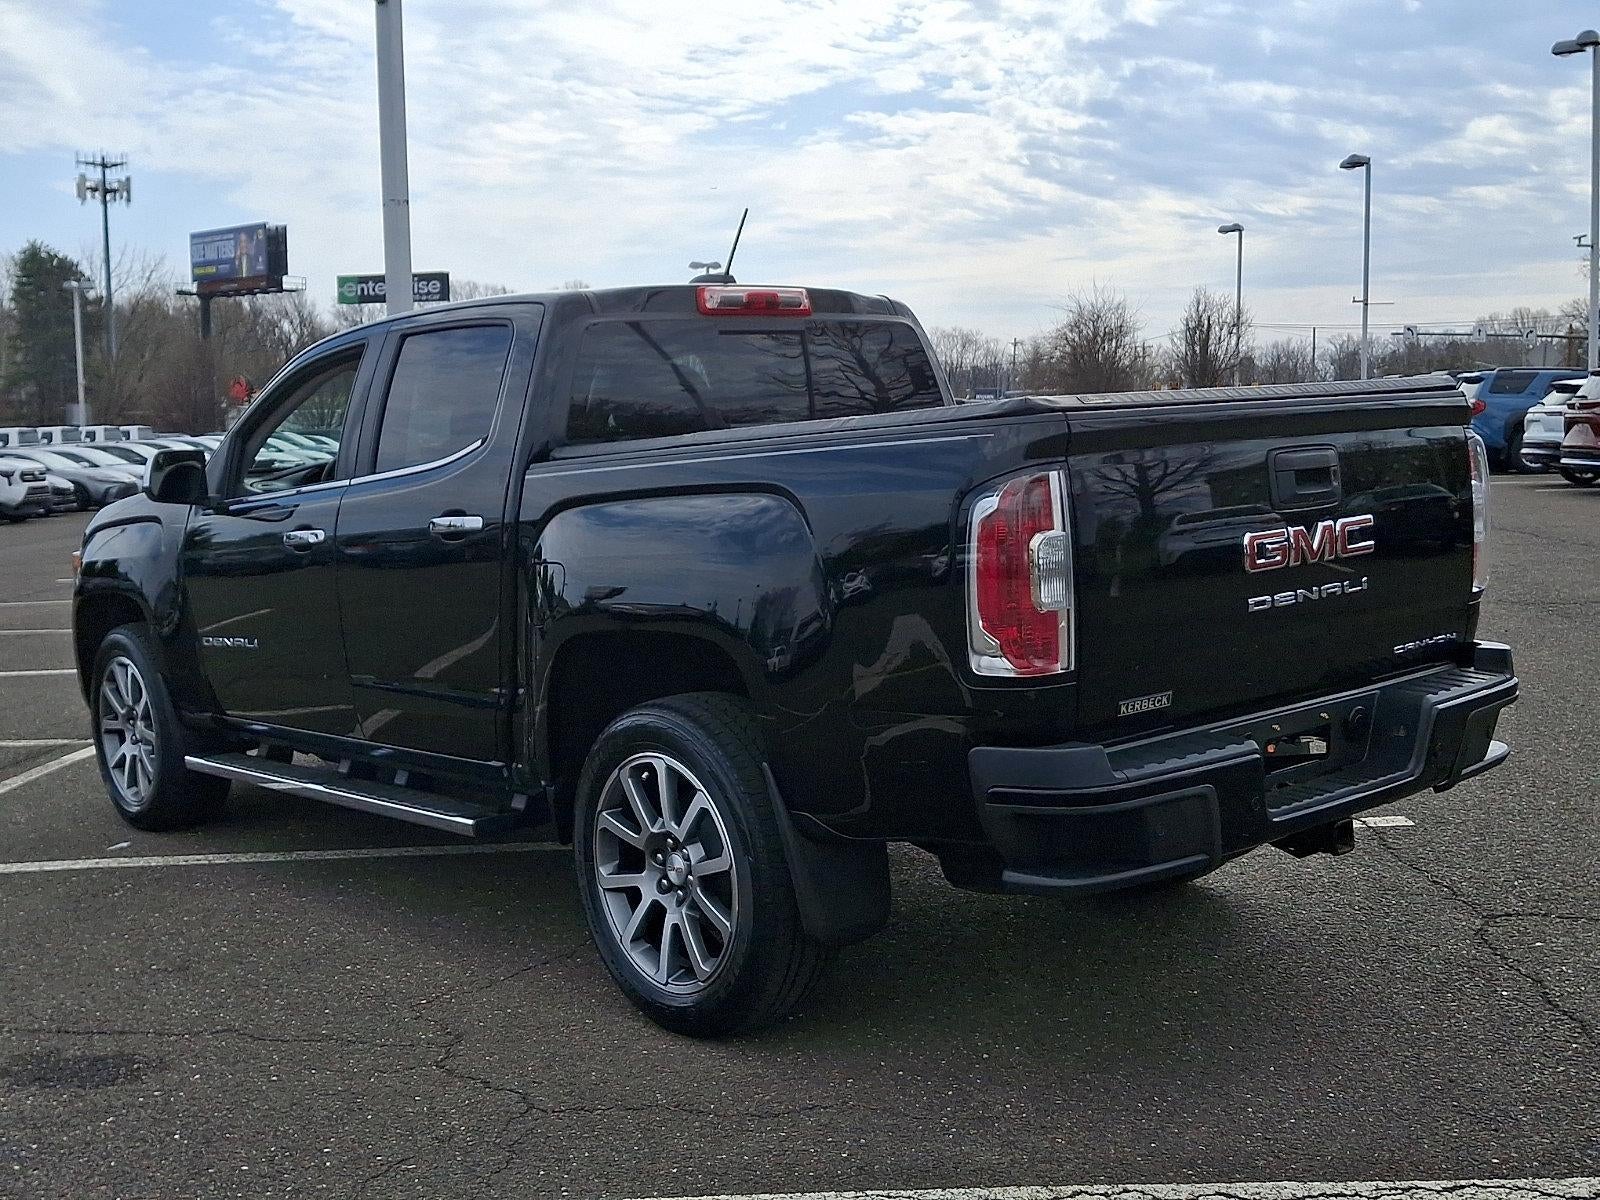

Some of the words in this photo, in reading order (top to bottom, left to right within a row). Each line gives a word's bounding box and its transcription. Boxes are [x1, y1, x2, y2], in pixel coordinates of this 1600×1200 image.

[341, 277, 440, 297] enteise
[1244, 514, 1375, 573] GMC
[1248, 576, 1369, 613] DENALI
[202, 636, 259, 648] DENALI
[1393, 632, 1457, 654] CANYON
[1120, 694, 1169, 716] KERBECK
